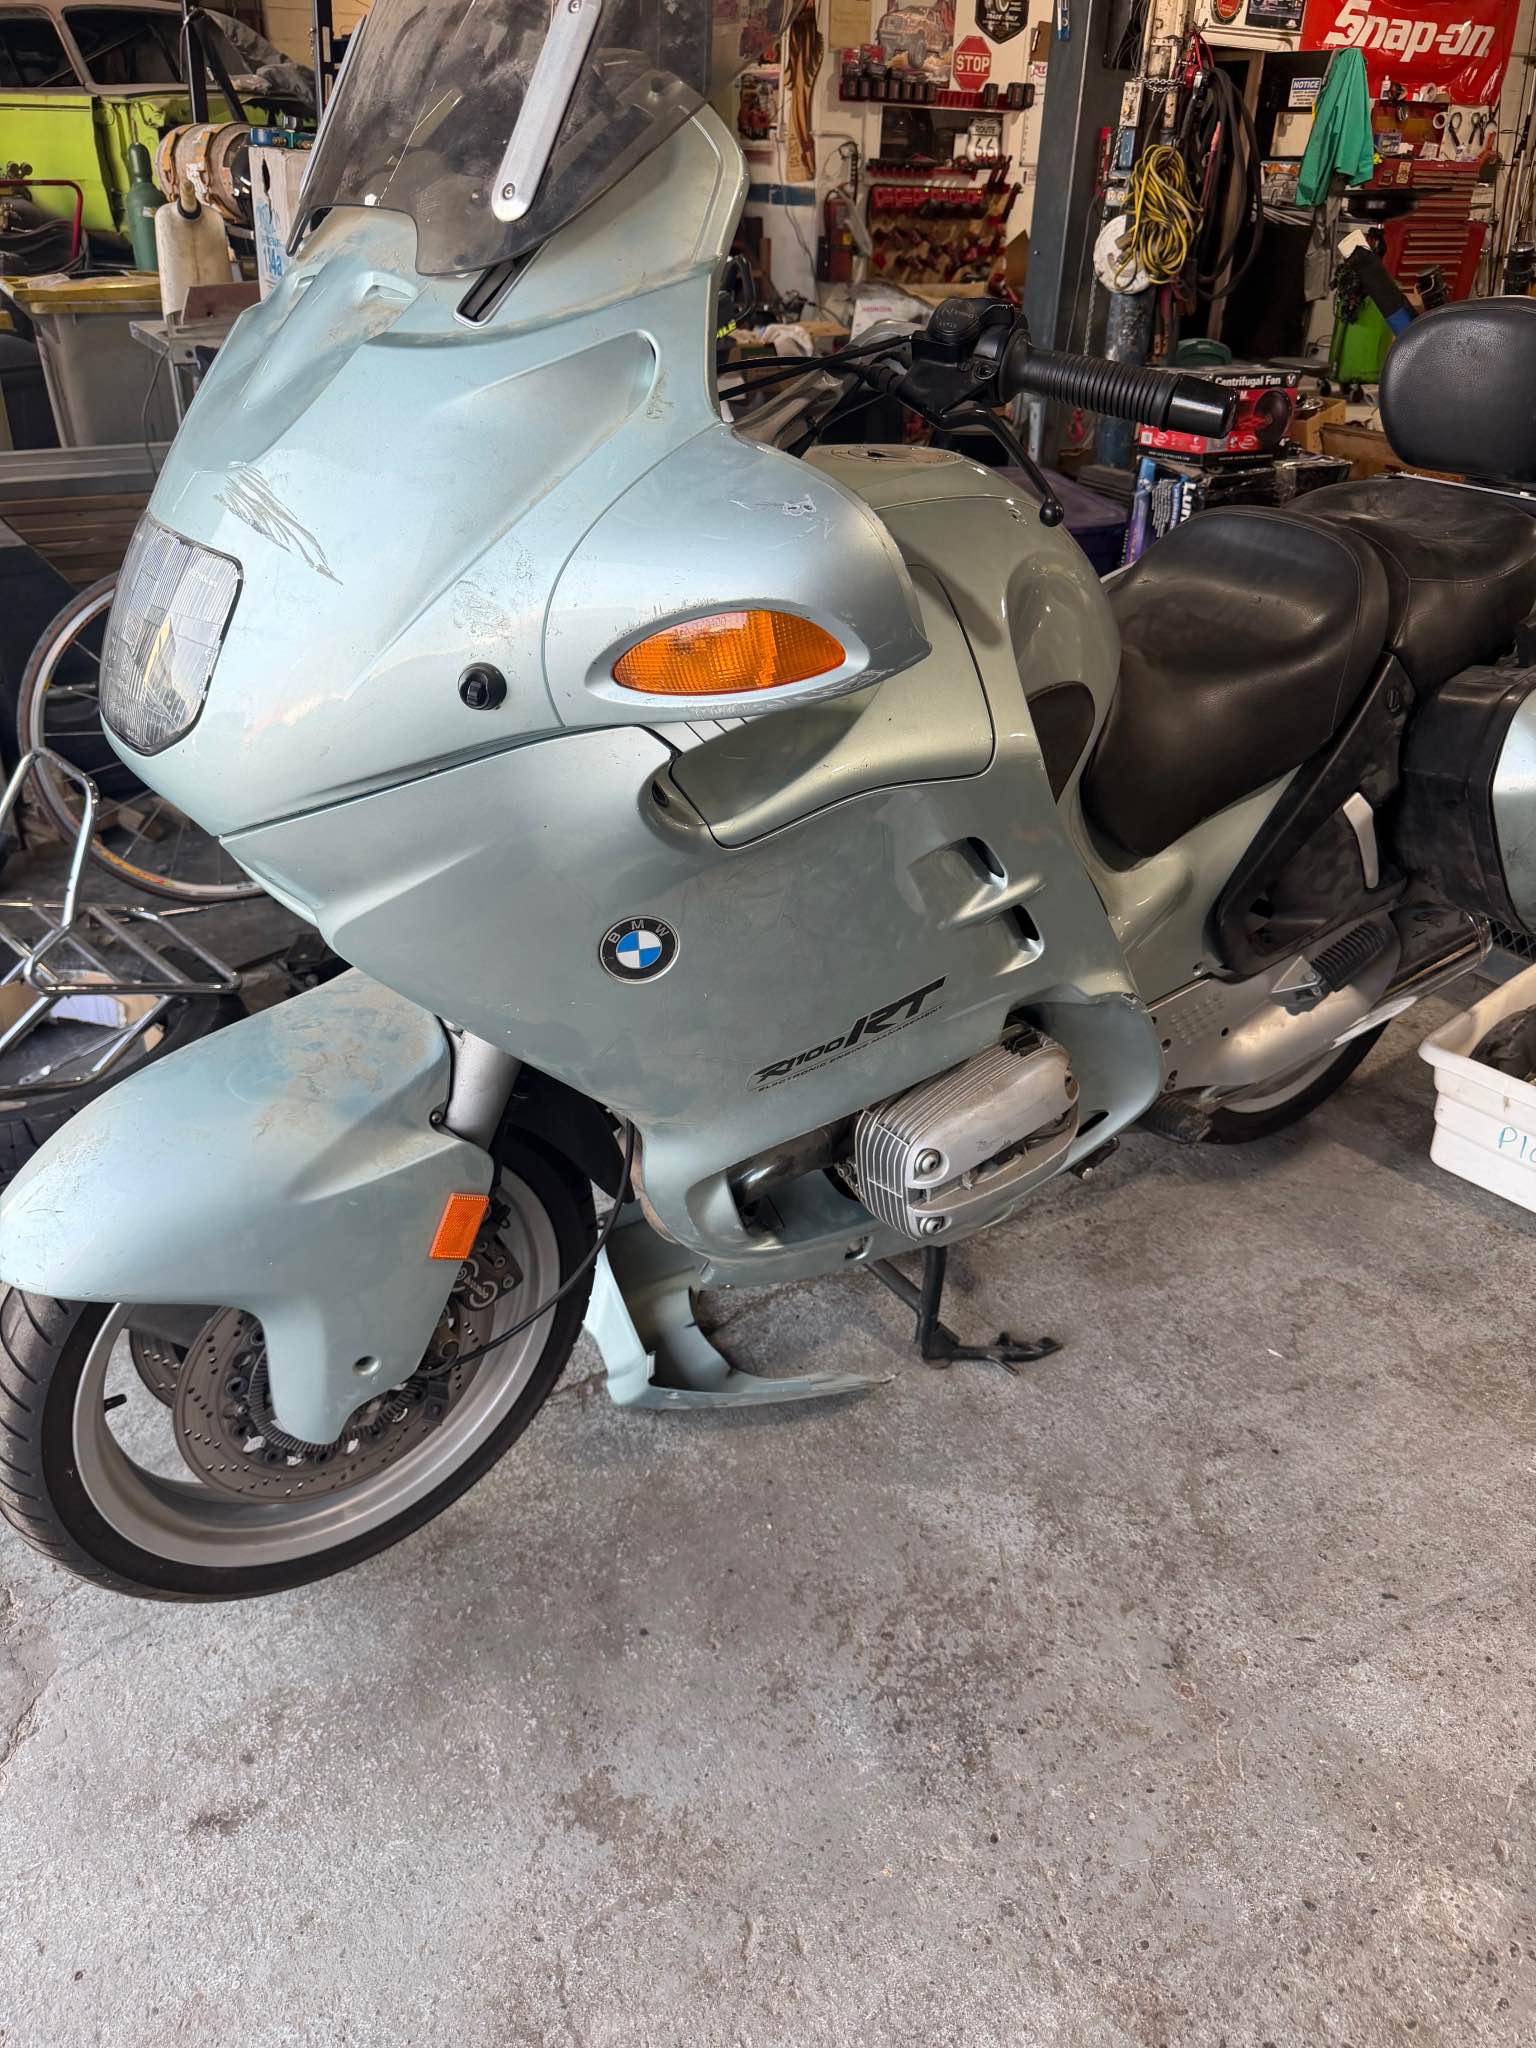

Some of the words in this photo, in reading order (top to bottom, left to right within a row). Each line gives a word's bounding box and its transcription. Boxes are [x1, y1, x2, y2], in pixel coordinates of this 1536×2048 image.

[1324, 0, 1496, 63] Snap-on
[956, 55, 990, 73] STOP
[1293, 80, 1321, 89] NOTICE
[974, 138, 998, 157] 66
[1215, 375, 1264, 388] Centrifugal
[1265, 375, 1281, 386] Fan
[608, 919, 670, 944] BMW
